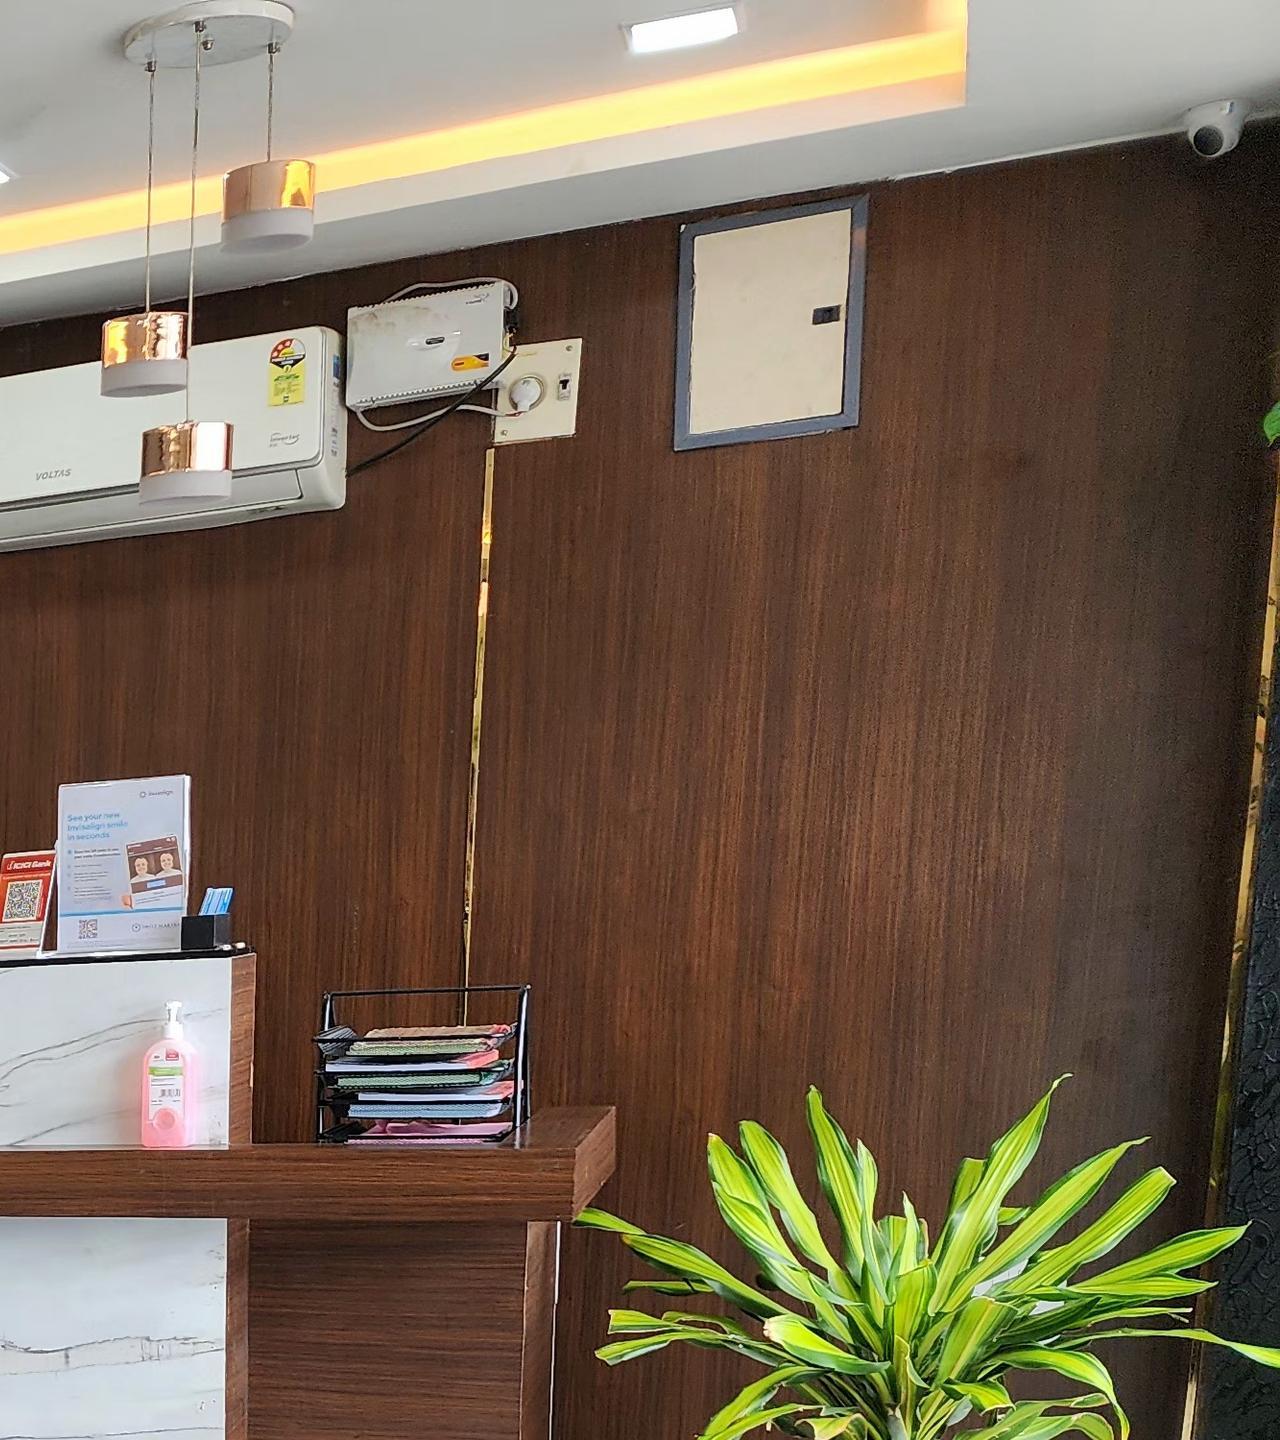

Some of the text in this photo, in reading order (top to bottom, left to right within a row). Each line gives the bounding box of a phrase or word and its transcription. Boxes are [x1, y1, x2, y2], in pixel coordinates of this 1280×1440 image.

[35, 468, 72, 481] VOLTAS
[84, 814, 101, 822] your
[32, 860, 51, 868] Bank
